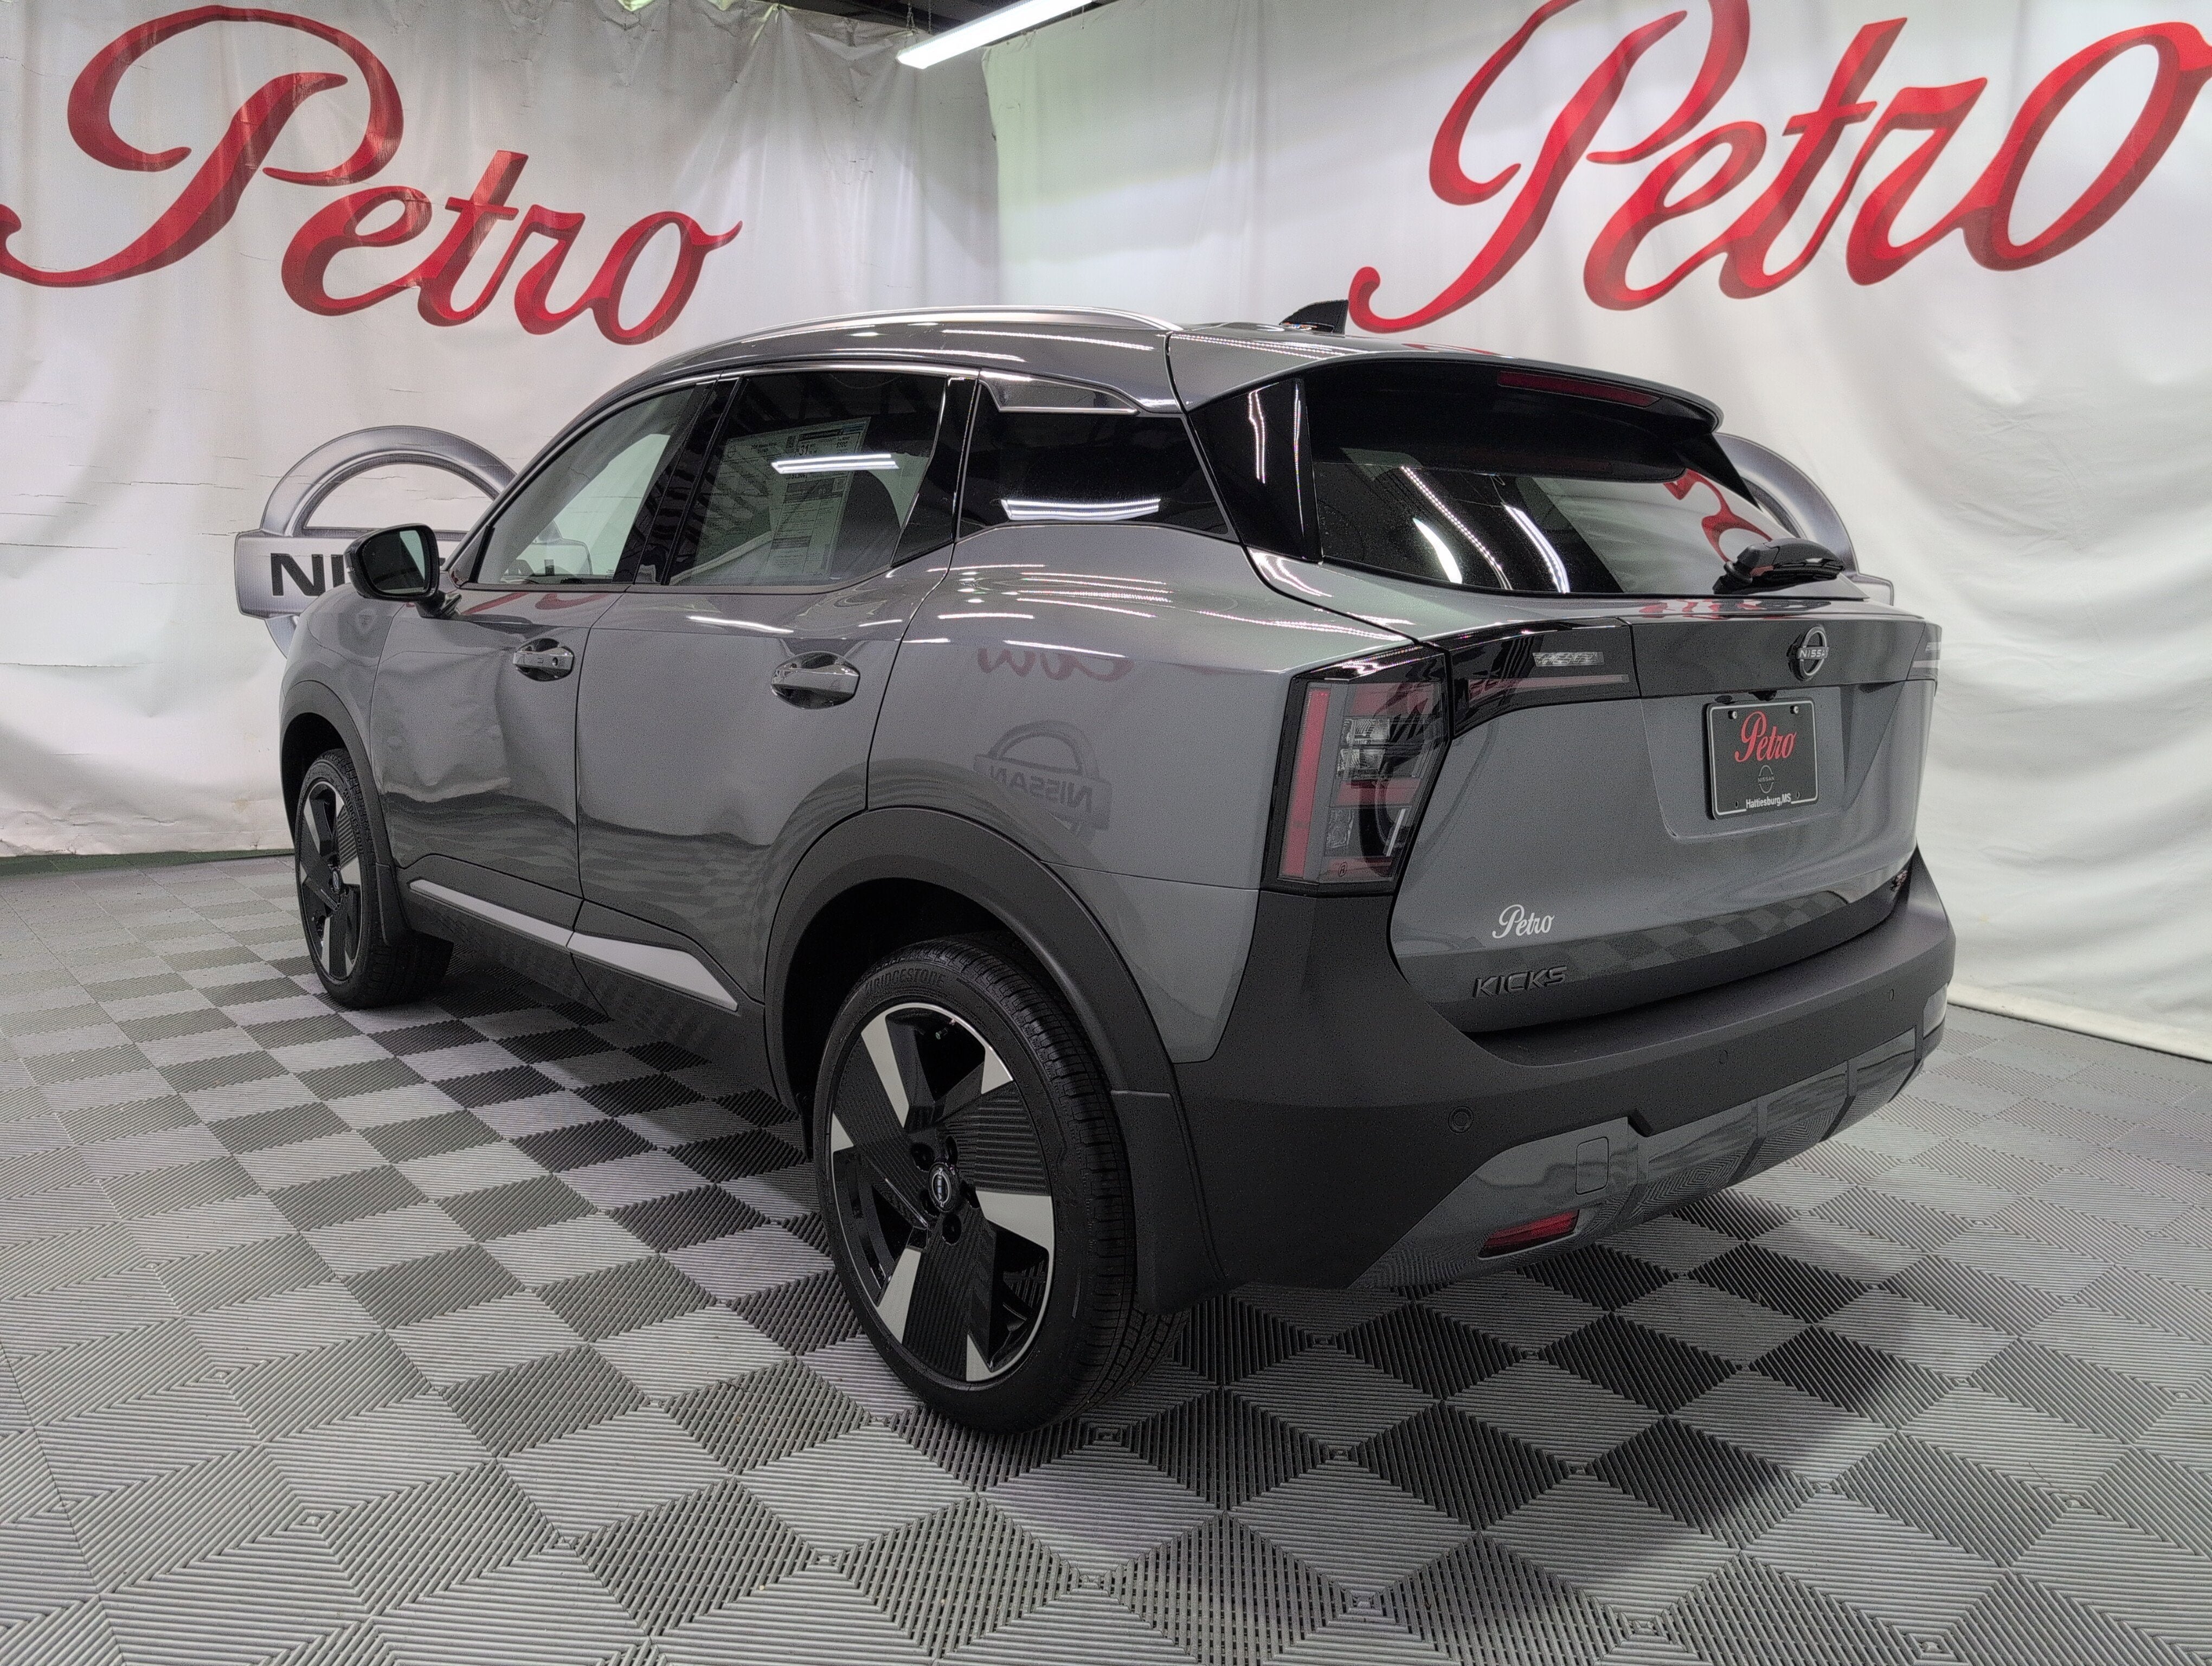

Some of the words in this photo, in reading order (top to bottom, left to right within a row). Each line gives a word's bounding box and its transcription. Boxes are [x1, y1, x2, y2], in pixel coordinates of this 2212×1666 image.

[0, 5, 742, 345] Petro
[1348, 0, 2212, 334] Petro
[1735, 710, 1797, 762] Petro
[1746, 793, 1791, 809] Hattiesburg,MS
[1492, 904, 1555, 939] Petro
[1472, 965, 1567, 998] KICKS
